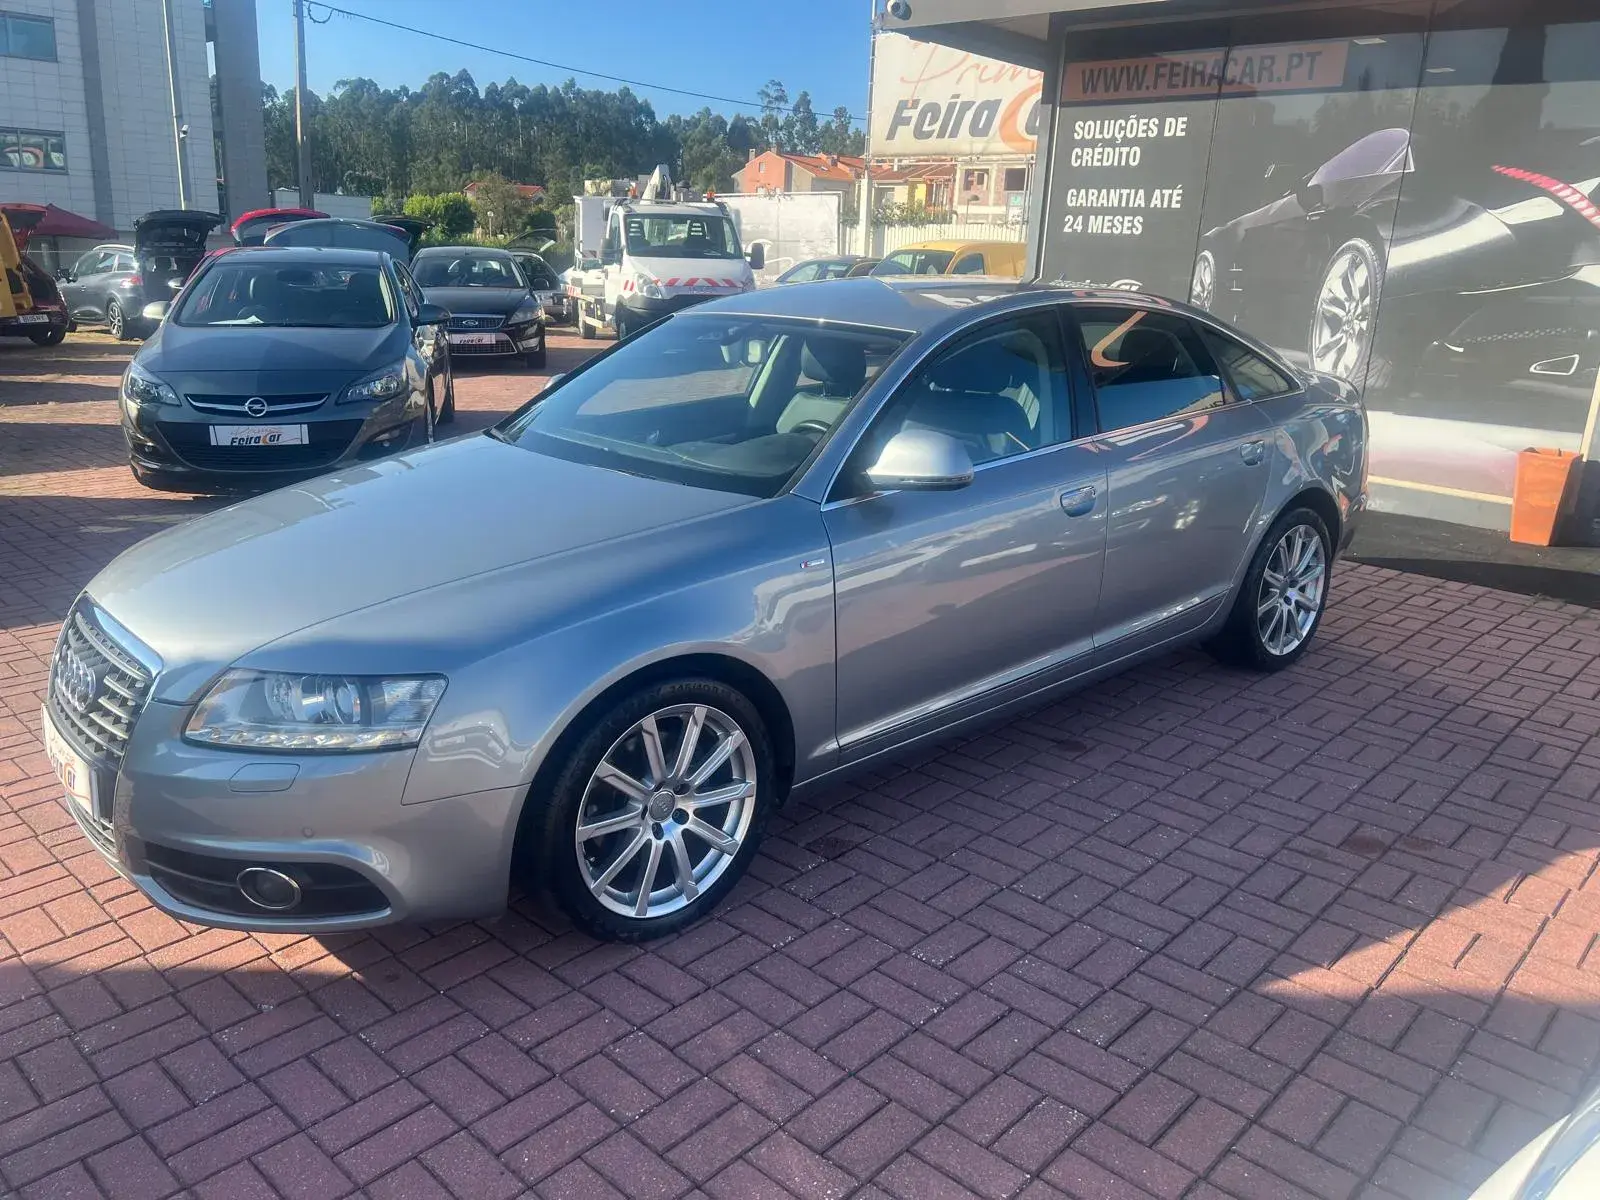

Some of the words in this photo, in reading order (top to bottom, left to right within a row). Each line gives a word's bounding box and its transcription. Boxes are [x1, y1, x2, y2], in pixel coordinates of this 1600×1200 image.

[1081, 51, 1322, 95] WWW.FEIRACAR.PT
[1073, 114, 1159, 143] SOLUÇÕES
[1164, 117, 1188, 137] DE
[1071, 143, 1141, 167] CRÉDITO
[1066, 188, 1145, 208] GARANTIA
[1150, 184, 1183, 209] ATÉ
[1063, 215, 1083, 233] 24
[1087, 215, 1144, 235] MESES
